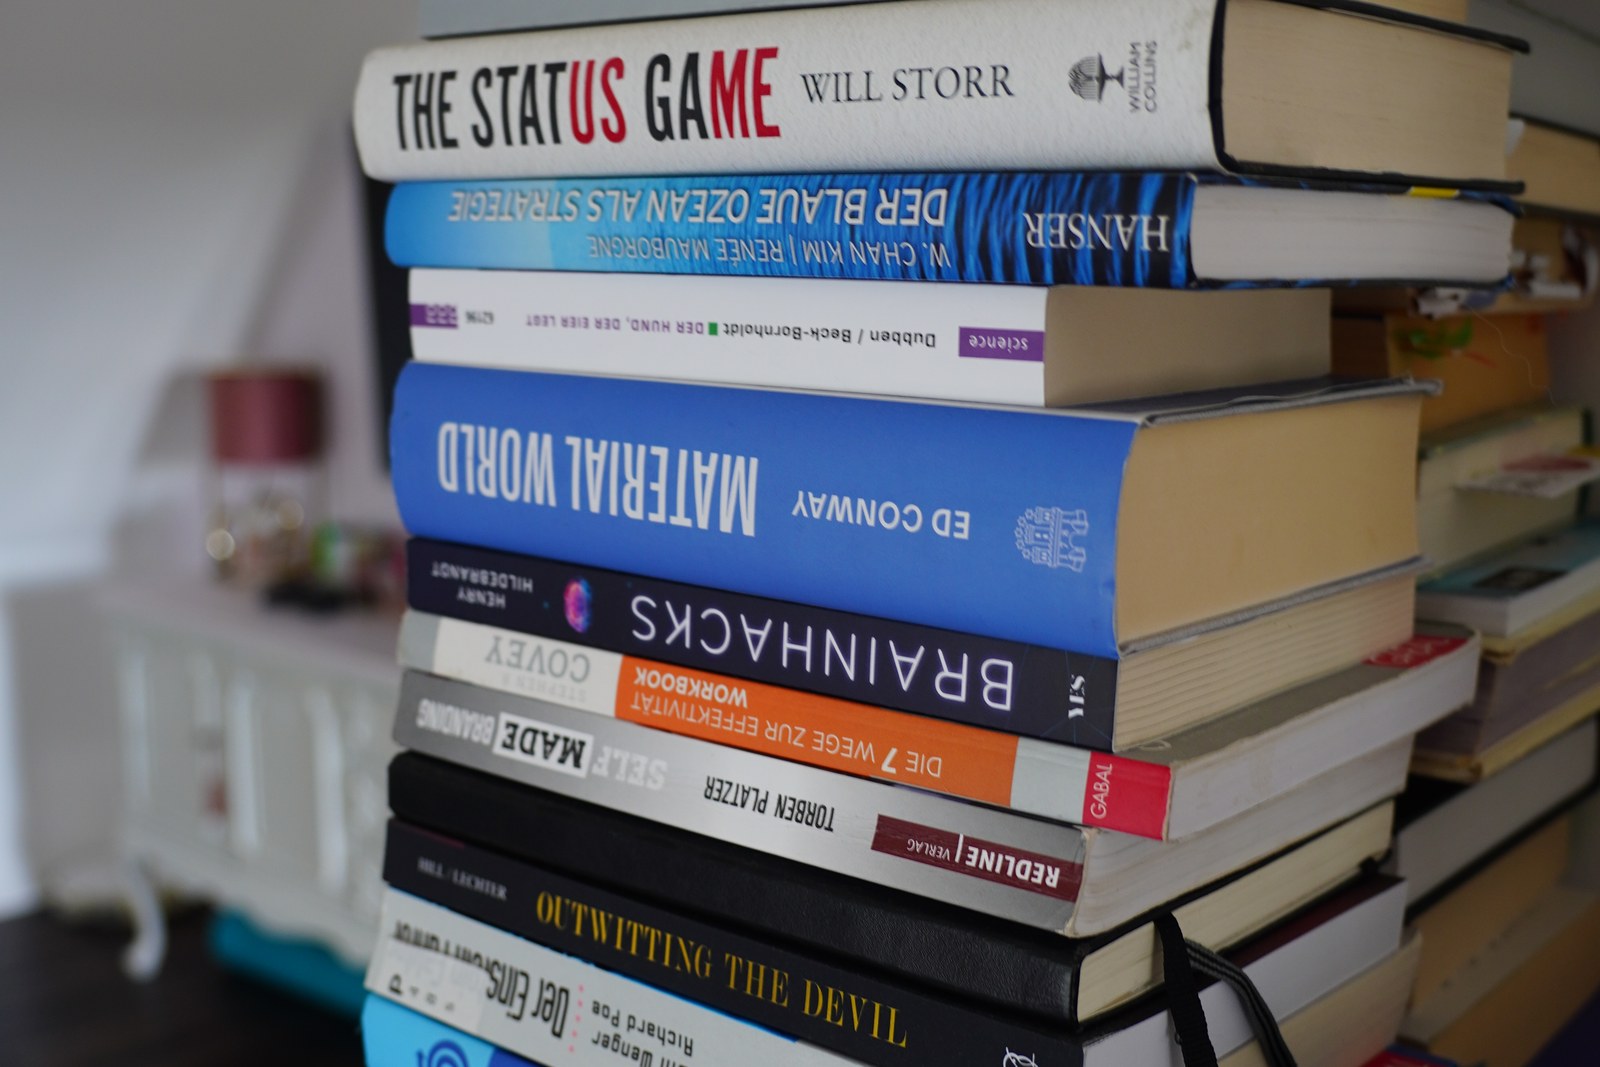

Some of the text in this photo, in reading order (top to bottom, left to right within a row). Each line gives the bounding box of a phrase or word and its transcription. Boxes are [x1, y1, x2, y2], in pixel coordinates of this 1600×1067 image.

[800, 64, 1015, 104] WILL STORR
[1128, 42, 1141, 113] WILLIAM
[1144, 41, 1157, 112] COLLINS
[393, 47, 781, 150] THE STATUS GAME
[448, 188, 949, 226] DER BLAUE OZEAN ALS STRATEGIE
[586, 235, 709, 261] MAUBORGNE
[714, 238, 783, 267] RENÉE
[802, 240, 845, 265] KIM
[849, 240, 916, 267] CHAN
[1024, 212, 1170, 252] HANSER
[923, 242, 951, 268] W.
[526, 314, 704, 335] DER HUND, DER EIER LEGT
[723, 322, 852, 343] Beck-Bornholdt
[870, 330, 936, 348] Dubben
[967, 334, 1029, 354] science
[438, 421, 758, 537] MATERIAL WORLD
[791, 490, 971, 540] ED CONWAY
[431, 561, 533, 592] HILDEBRANDT
[457, 586, 506, 608] HENRY
[485, 635, 591, 684] COVEY
[631, 595, 1014, 711] BRAINHACKS
[634, 665, 747, 708] WORKBOOK
[416, 699, 668, 790] SELF MADE BRANDING
[631, 694, 942, 778] DIE 7 WEGE ZUR EFFEKTIVITÄT
[704, 775, 834, 832] TORBEN PLATZER
[1090, 763, 1113, 819] GABAL
[906, 838, 1060, 888] REDLINE VERLAG
[536, 890, 713, 979] OUTWITTING
[725, 952, 789, 1008] THE
[802, 978, 908, 1049] DEVIL
[531, 978, 570, 1039] Der
[592, 1000, 693, 1057] Richard Poe
[591, 1031, 653, 1067] Wenger
